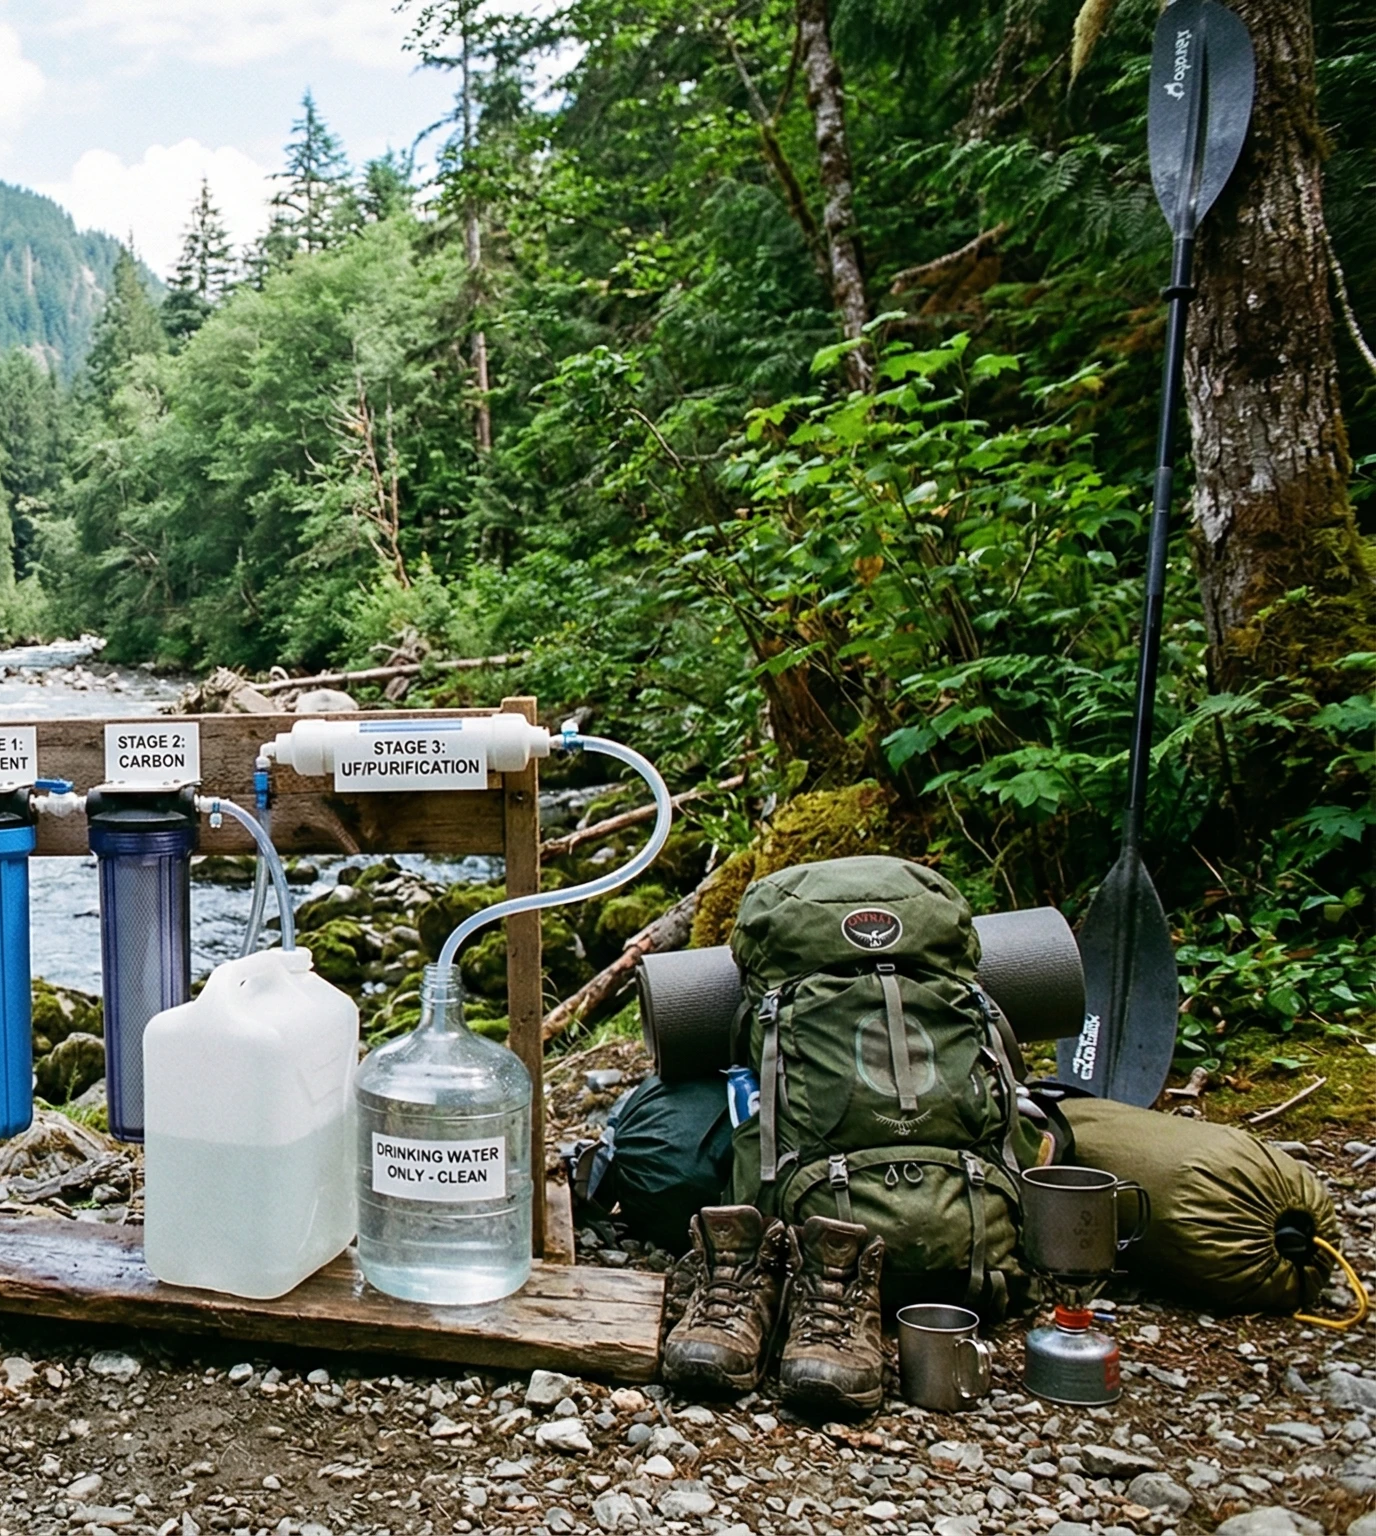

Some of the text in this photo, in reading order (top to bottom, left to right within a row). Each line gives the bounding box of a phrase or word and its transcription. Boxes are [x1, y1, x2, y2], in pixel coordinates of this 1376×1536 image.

[11, 738, 23, 751] 1:
[118, 734, 185, 750] STAGE 2:
[374, 739, 446, 756] STAGE 3:
[119, 753, 185, 769] CARBON
[341, 759, 480, 777] UF/PURIFICATION
[376, 1142, 499, 1164] DRINKING WATER
[387, 1164, 425, 1182] ONLY
[437, 1169, 487, 1184] CLEAN
